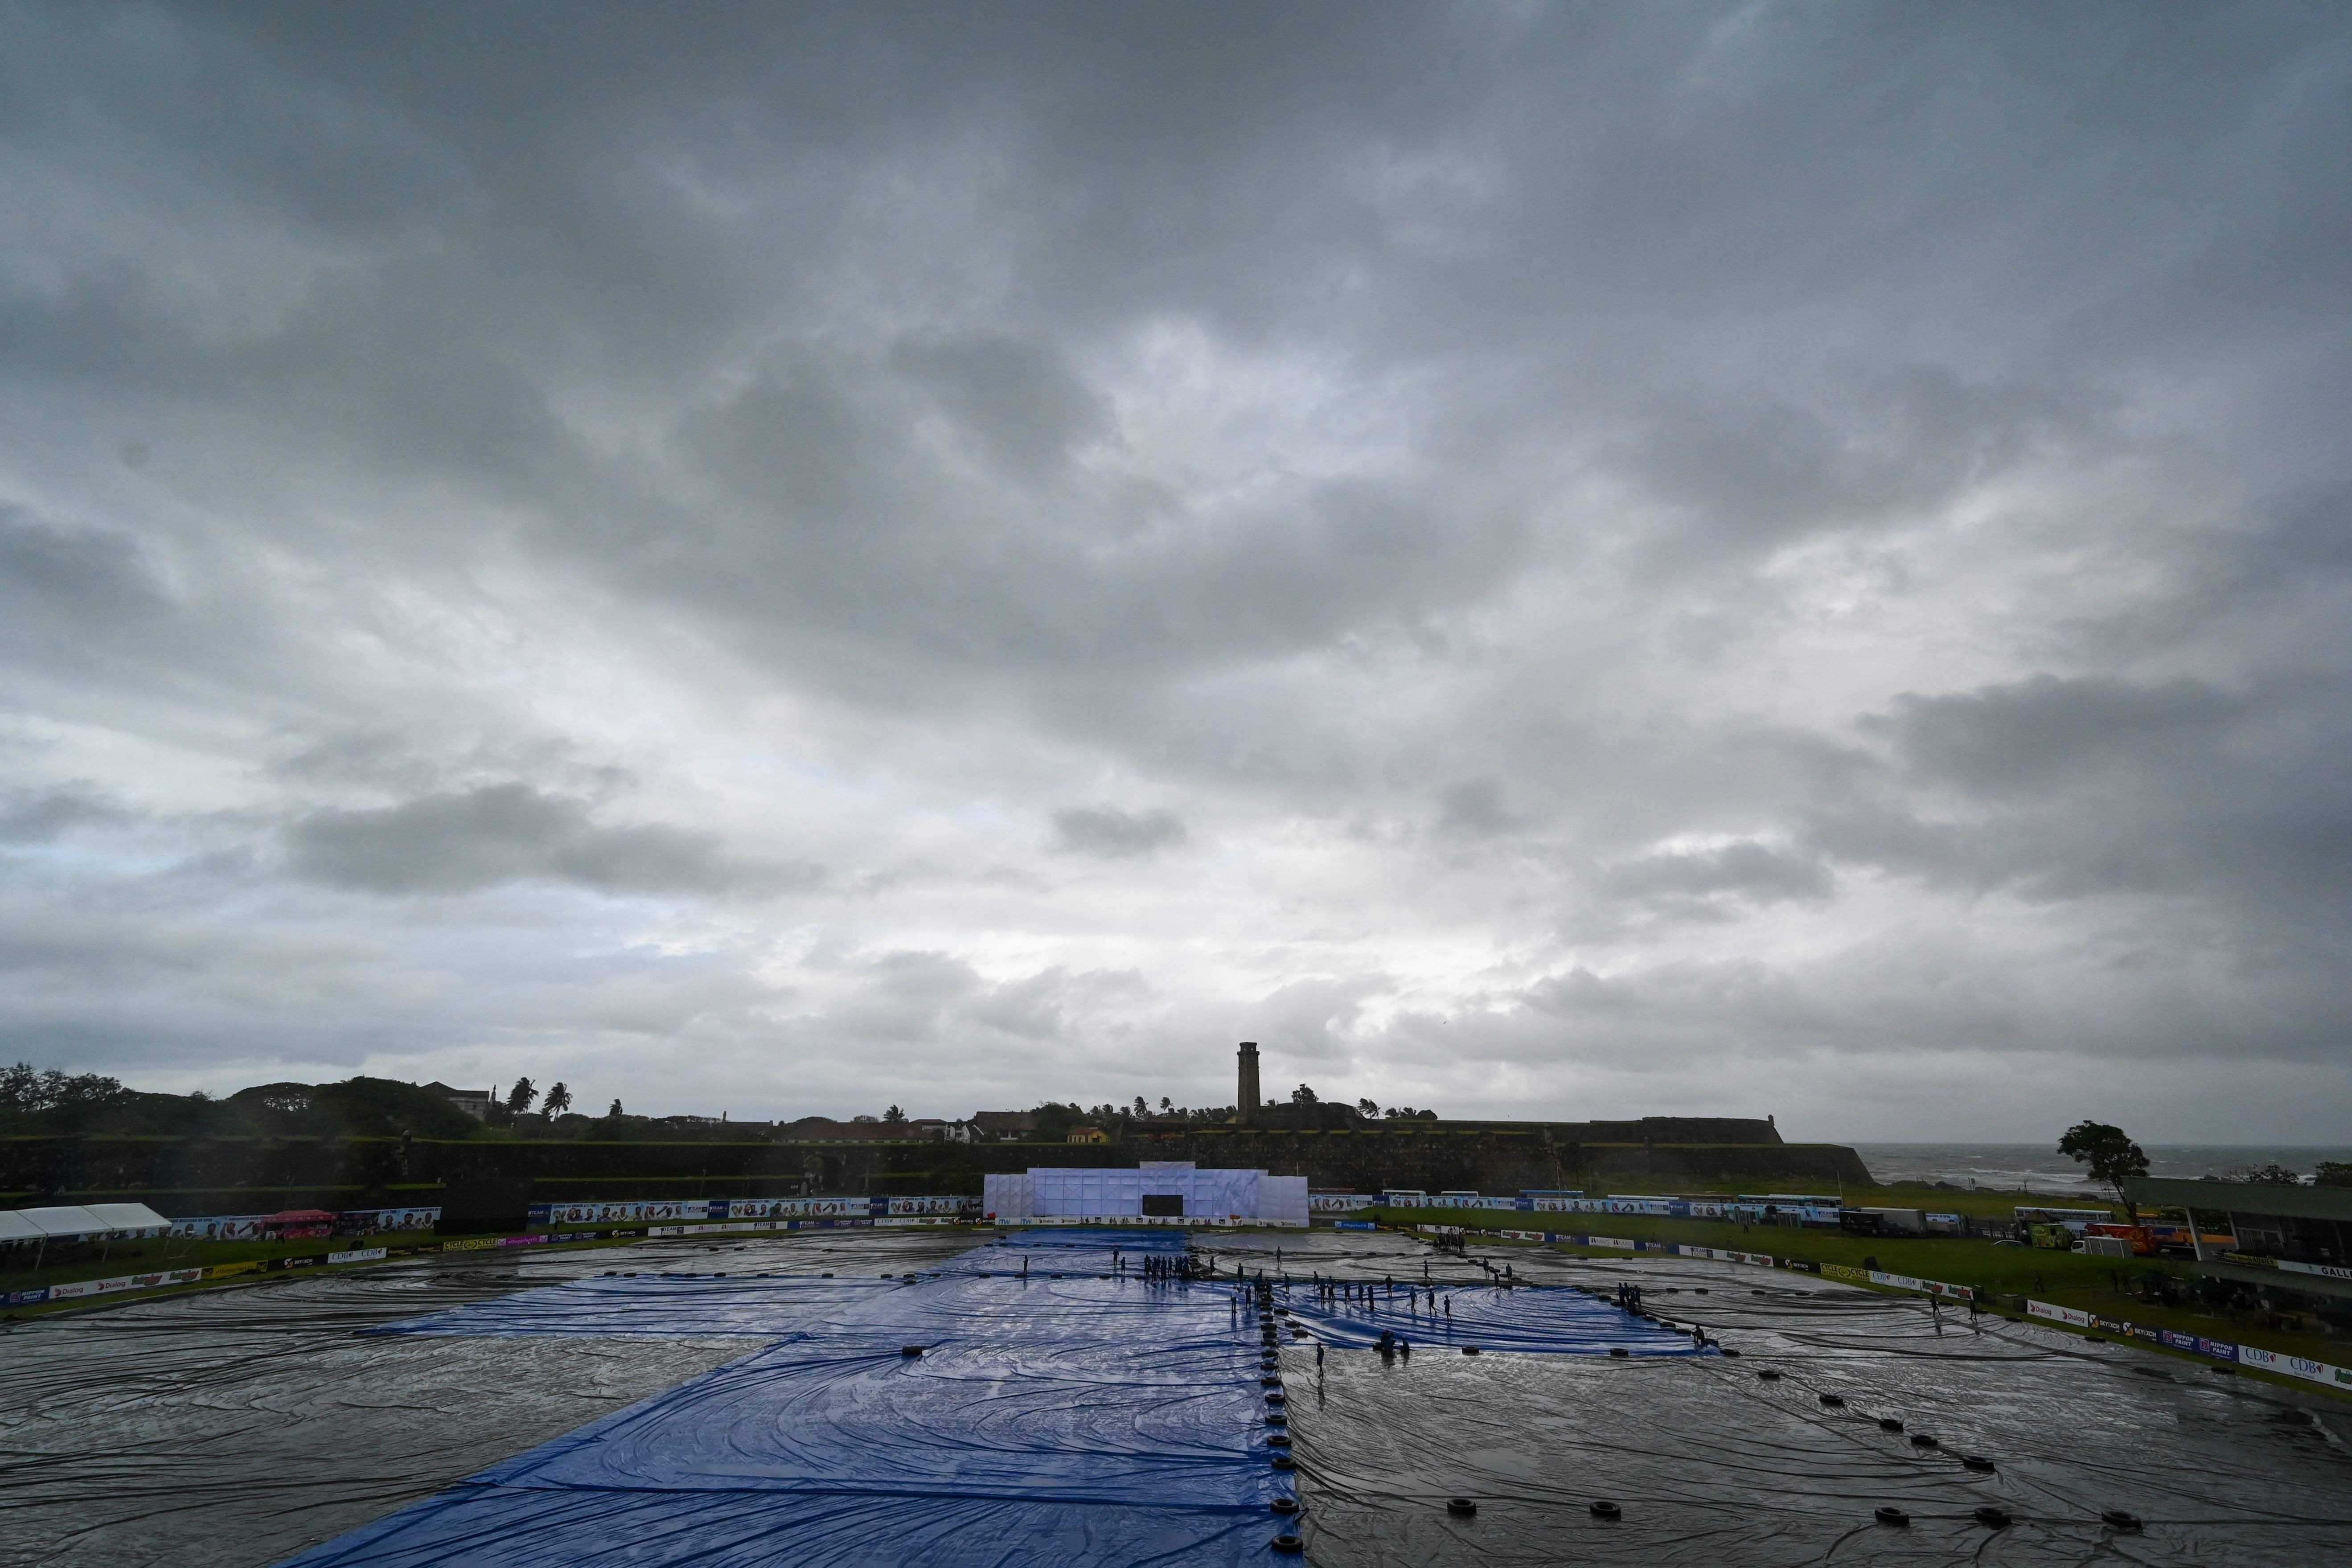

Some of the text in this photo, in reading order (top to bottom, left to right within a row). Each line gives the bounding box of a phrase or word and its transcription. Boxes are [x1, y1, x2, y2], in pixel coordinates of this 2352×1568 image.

[332, 1249, 378, 1260] CDB CDB
[1822, 1264, 1869, 1277] CYCLE CYCLE
[1873, 1271, 1912, 1285] CDB CDB
[2036, 1306, 2085, 1323] Dialog Dialog
[2173, 1333, 2233, 1351] NIPPON NIPPON
[2212, 1347, 2231, 1355] PAINT
[2246, 1347, 2269, 1363] CDB
[2290, 1358, 2316, 1374] CDB
